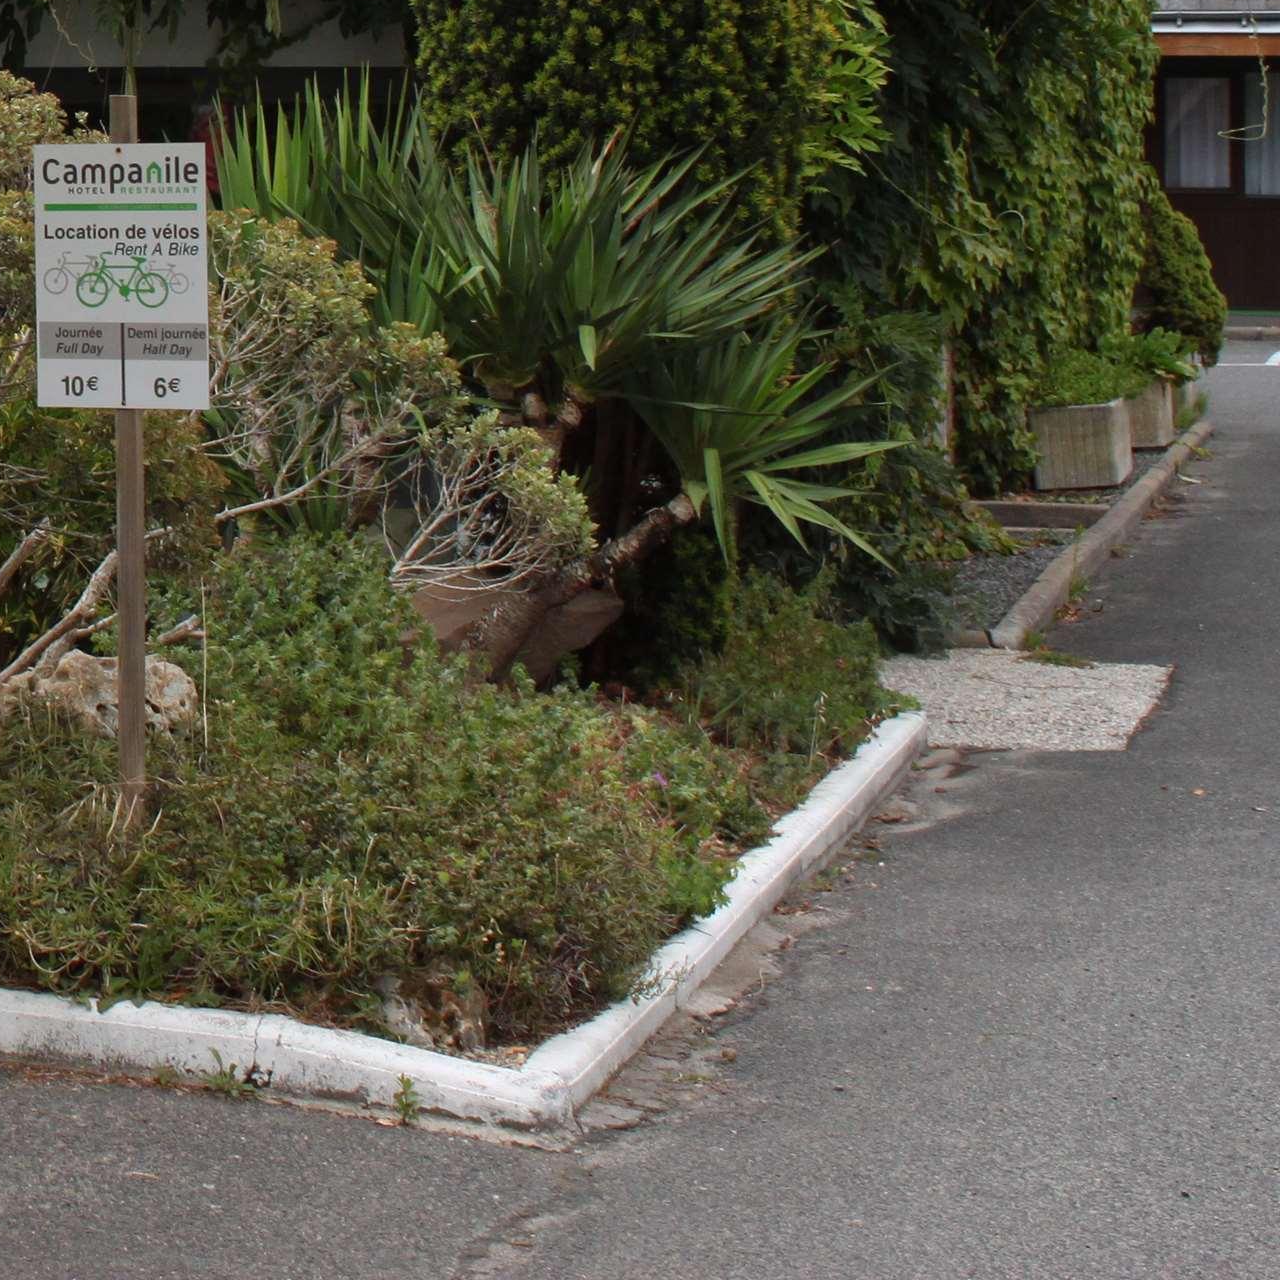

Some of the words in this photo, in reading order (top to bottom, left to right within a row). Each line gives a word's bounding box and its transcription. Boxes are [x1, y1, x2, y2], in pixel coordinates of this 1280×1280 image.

[42, 156, 199, 194] Campanile
[68, 186, 105, 195] HOTEL
[120, 185, 198, 195] RESTAURANT
[44, 223, 120, 240] Location
[125, 223, 146, 240] de
[152, 222, 200, 240] vélos
[113, 242, 148, 256] Rent
[151, 242, 163, 256] A
[168, 242, 199, 256] Bike
[54, 327, 104, 339] Journée
[127, 327, 159, 339] Demi
[161, 327, 207, 341] journée
[56, 342, 79, 354] Full
[81, 342, 105, 356] Day
[142, 343, 168, 355] Half
[169, 344, 193, 358] Day
[61, 375, 100, 397] 10€
[153, 376, 182, 398] 6€
